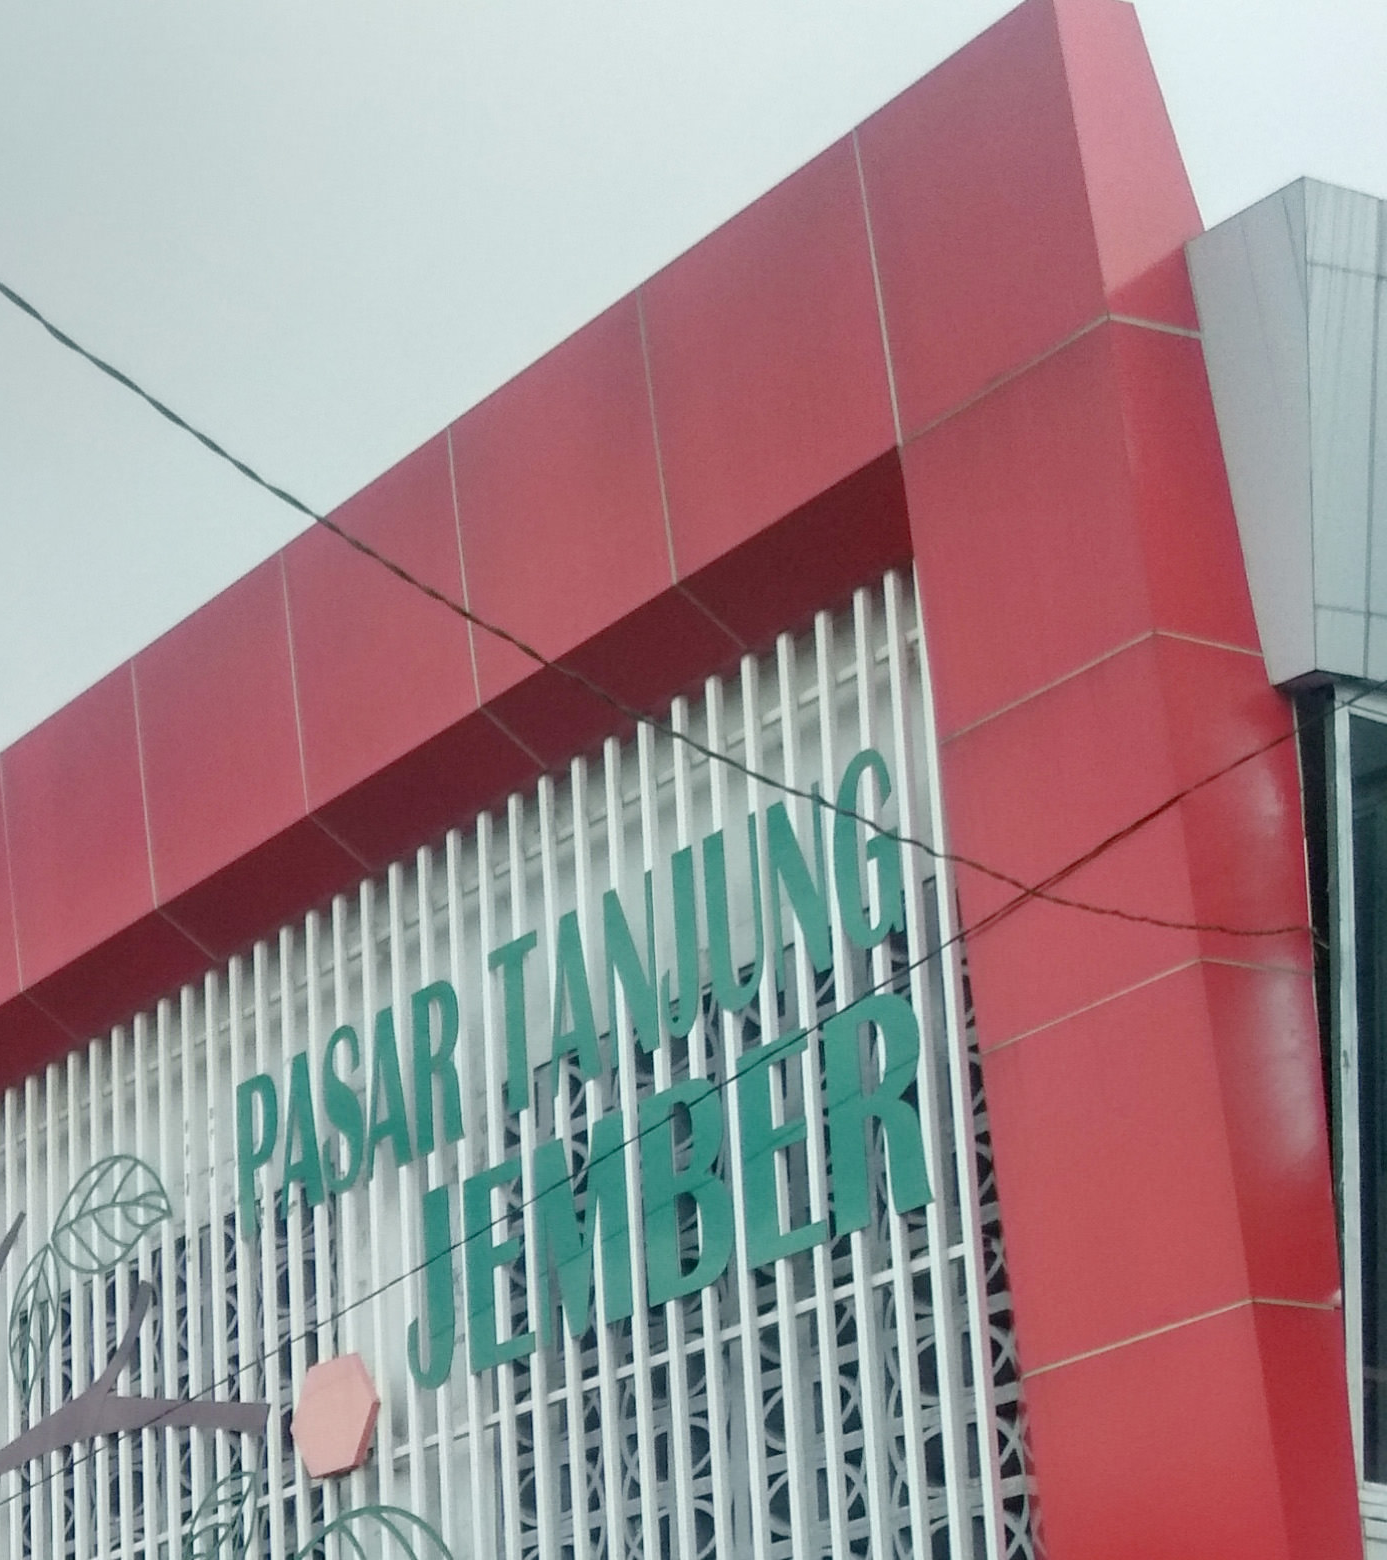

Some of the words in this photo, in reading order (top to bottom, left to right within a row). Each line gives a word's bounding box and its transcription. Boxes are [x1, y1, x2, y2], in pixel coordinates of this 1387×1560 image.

[236, 980, 464, 1241] PASAR
[488, 748, 907, 1115] TANJUNG
[407, 993, 935, 1390] JEMBER
